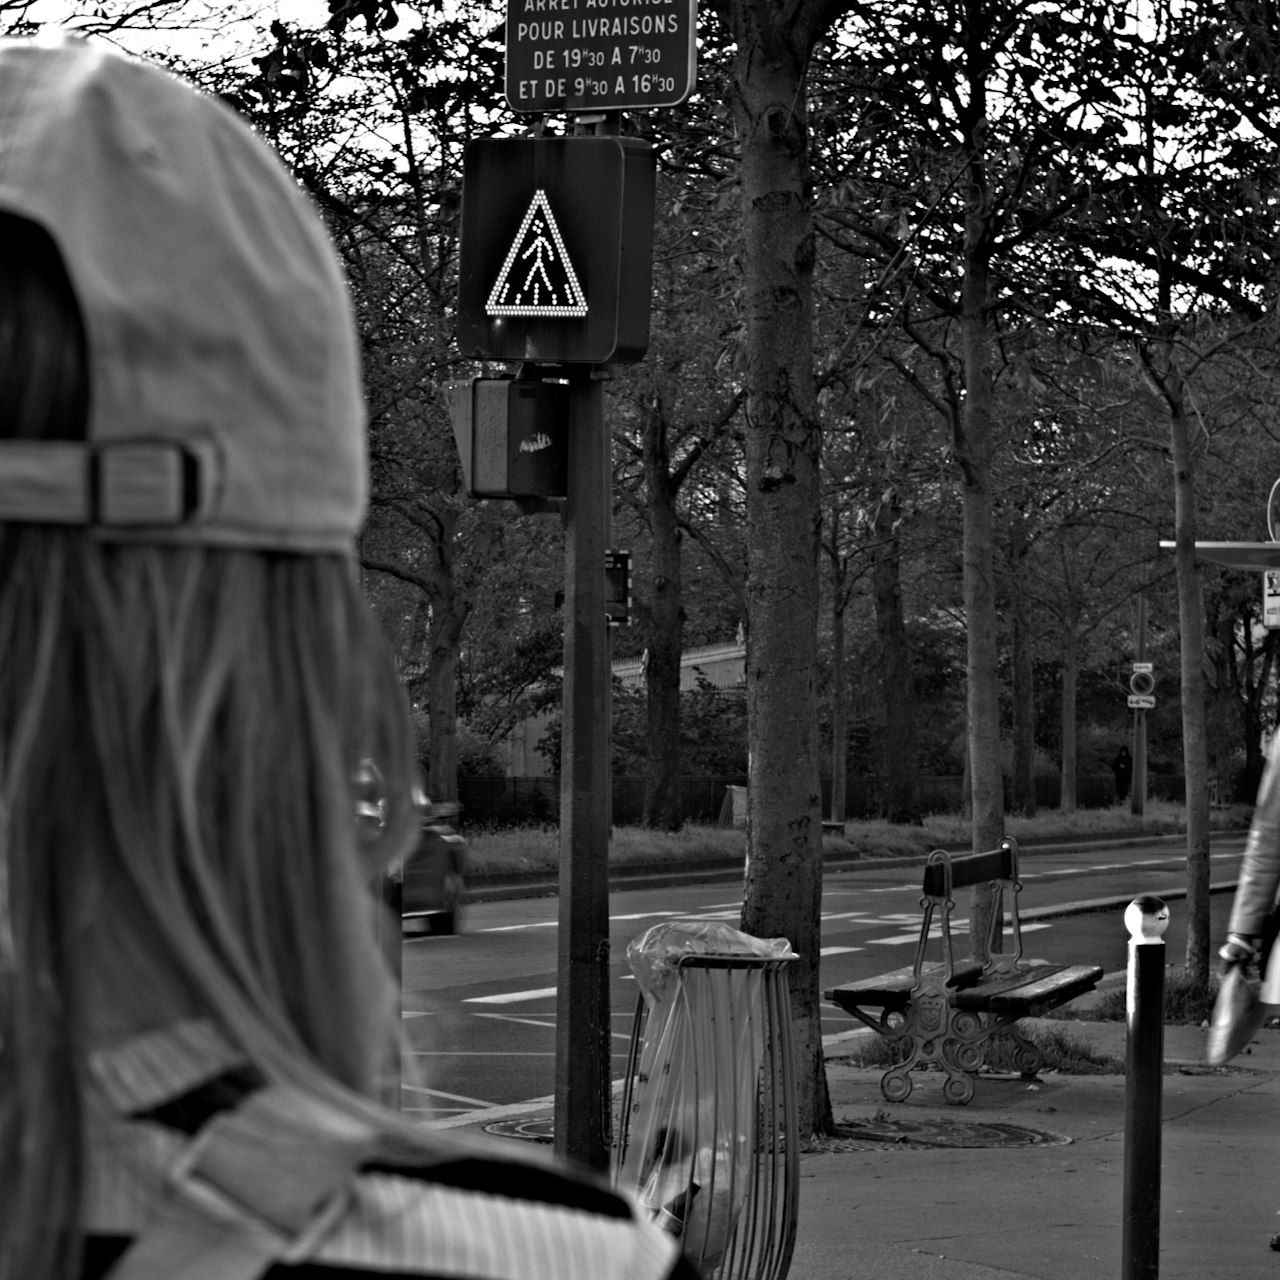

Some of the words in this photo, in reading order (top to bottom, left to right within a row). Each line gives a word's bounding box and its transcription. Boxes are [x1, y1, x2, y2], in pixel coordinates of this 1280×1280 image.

[518, 21, 564, 41] POUR
[572, 14, 678, 38] LIVRAISONS
[534, 51, 555, 69] DE
[611, 47, 621, 65] A
[520, 80, 538, 99] ET
[545, 79, 566, 98] DE
[615, 76, 625, 94] A
